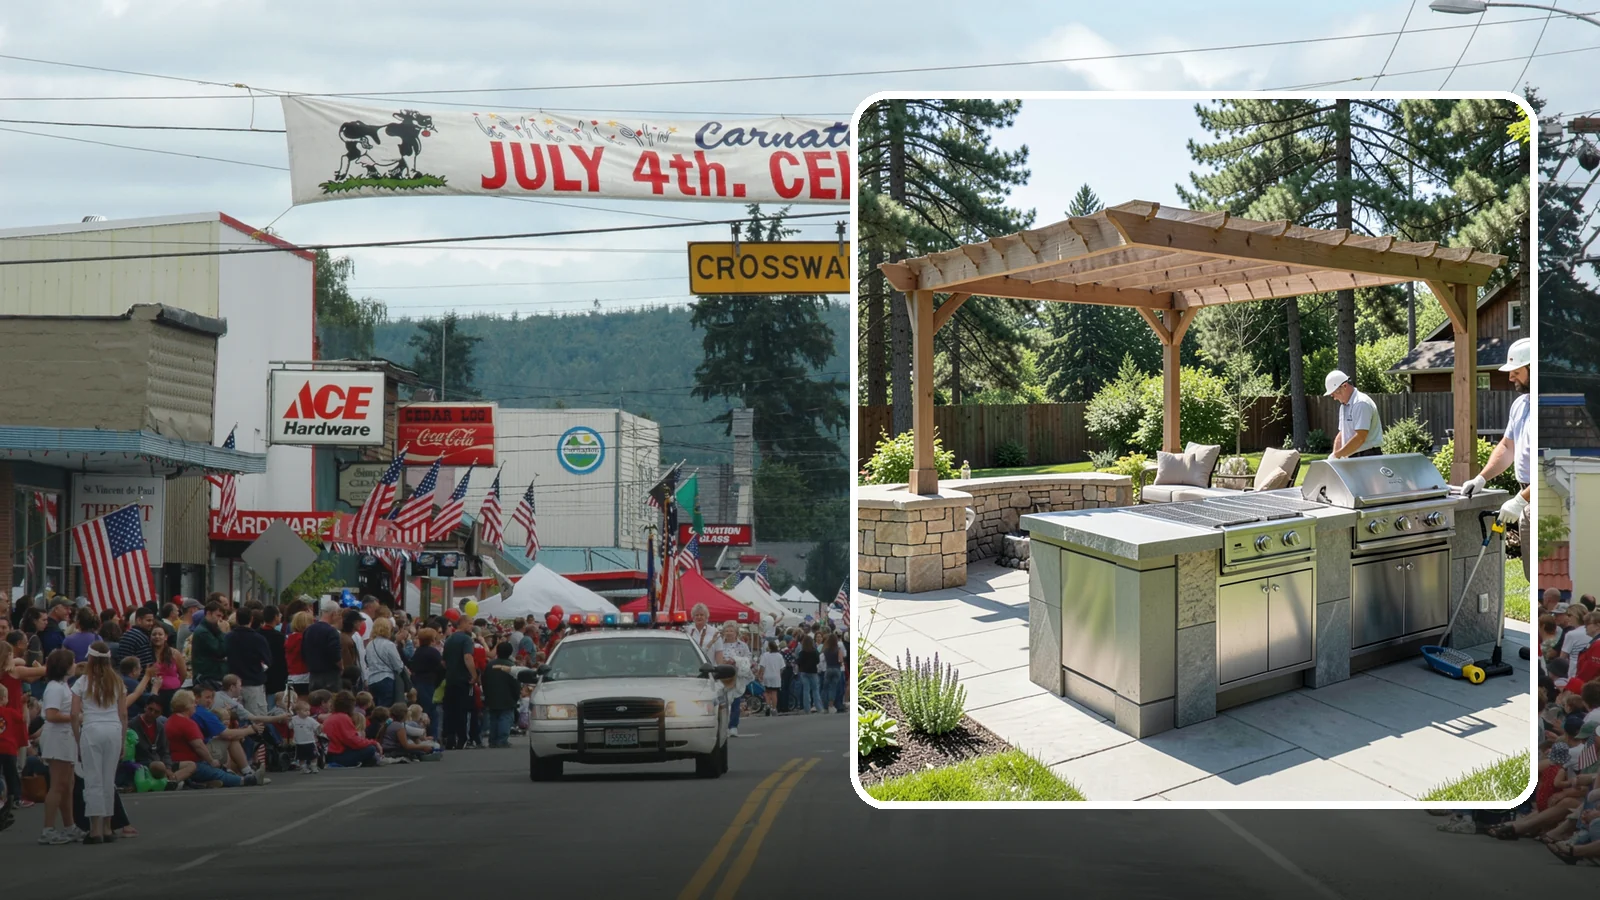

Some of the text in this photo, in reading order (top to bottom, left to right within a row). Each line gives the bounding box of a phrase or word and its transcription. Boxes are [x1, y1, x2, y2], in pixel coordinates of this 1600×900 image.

[481, 141, 604, 192] JULY
[632, 150, 746, 197] 4th.
[697, 254, 850, 279] CROSSWA
[283, 380, 373, 419] ACE
[405, 409, 452, 421] CEDAR
[283, 421, 371, 436] Hardware
[416, 428, 477, 446] Coca-Cola
[95, 485, 124, 494] Vincent
[126, 486, 135, 494] de
[137, 486, 155, 495] Paul
[699, 535, 730, 543] GLASS
